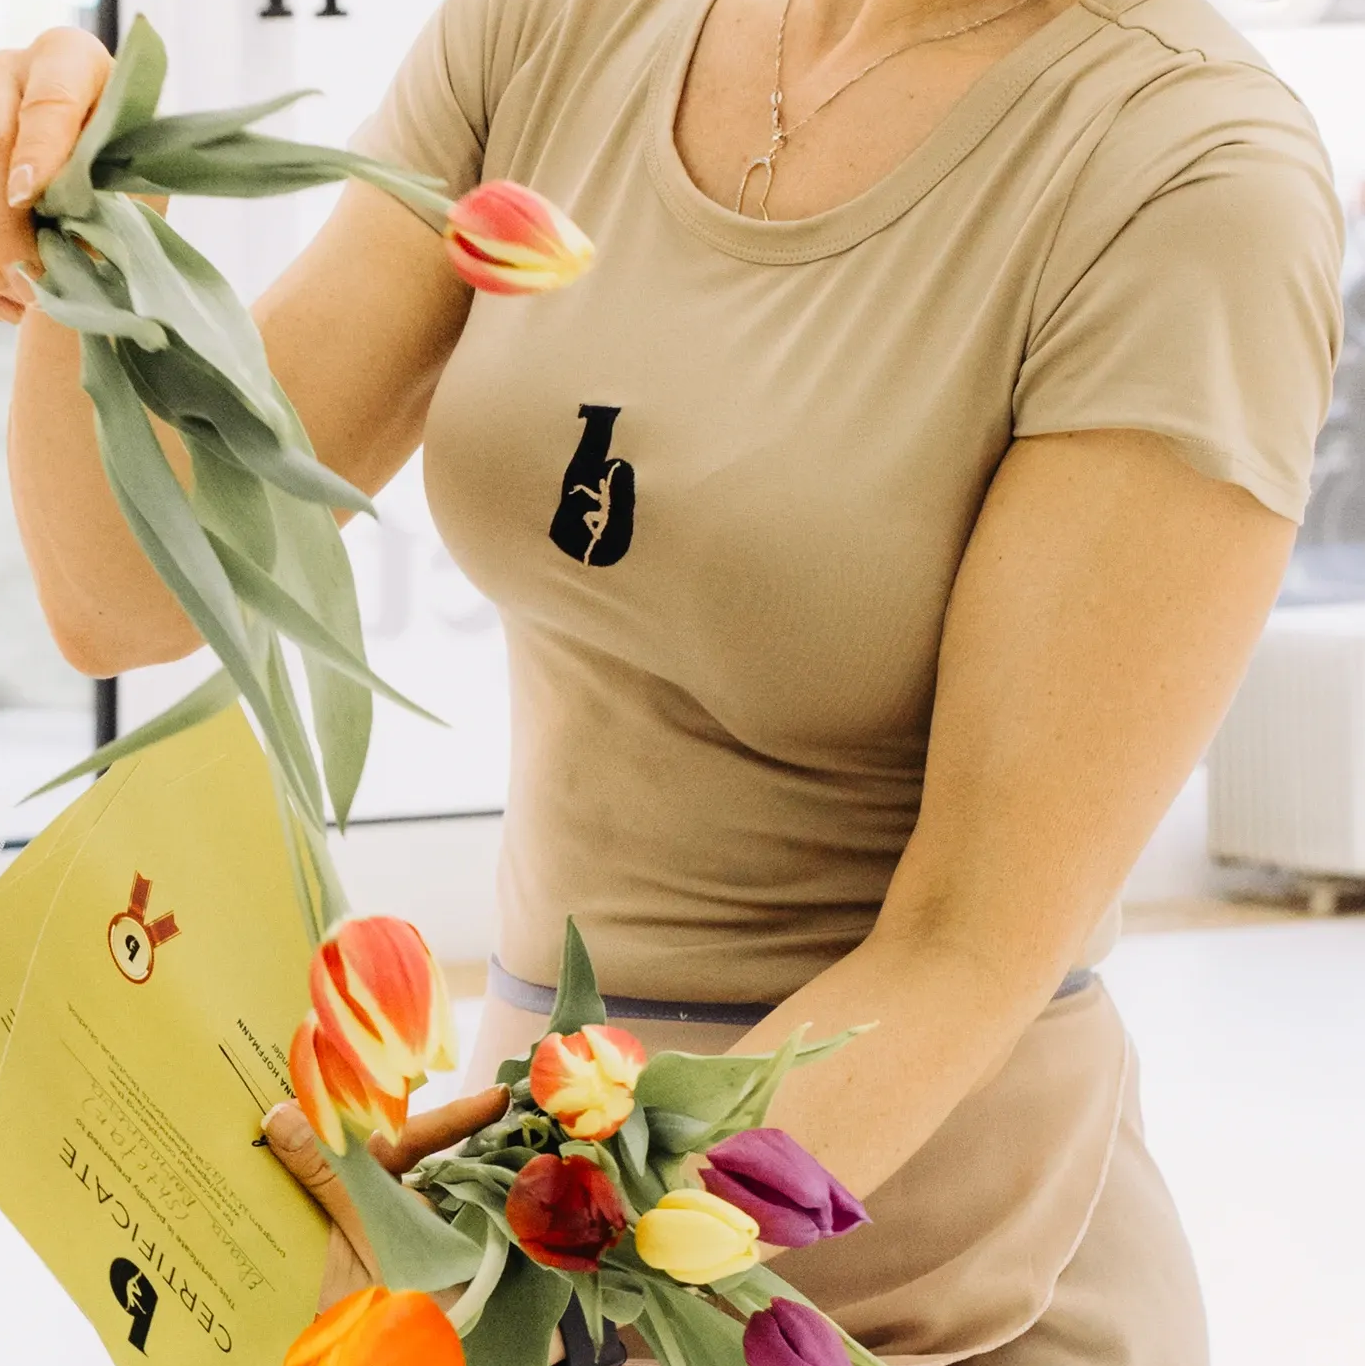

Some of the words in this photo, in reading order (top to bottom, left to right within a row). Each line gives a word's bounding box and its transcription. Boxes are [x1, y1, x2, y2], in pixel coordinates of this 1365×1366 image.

[236, 1018, 280, 1078] HOFFMANN
[85, 1127, 132, 1188] presented
[131, 1181, 166, 1228] proudly
[59, 1137, 232, 1353] CERTIFICATE
[173, 1233, 218, 1290] certificate
[217, 1285, 236, 1312] This
